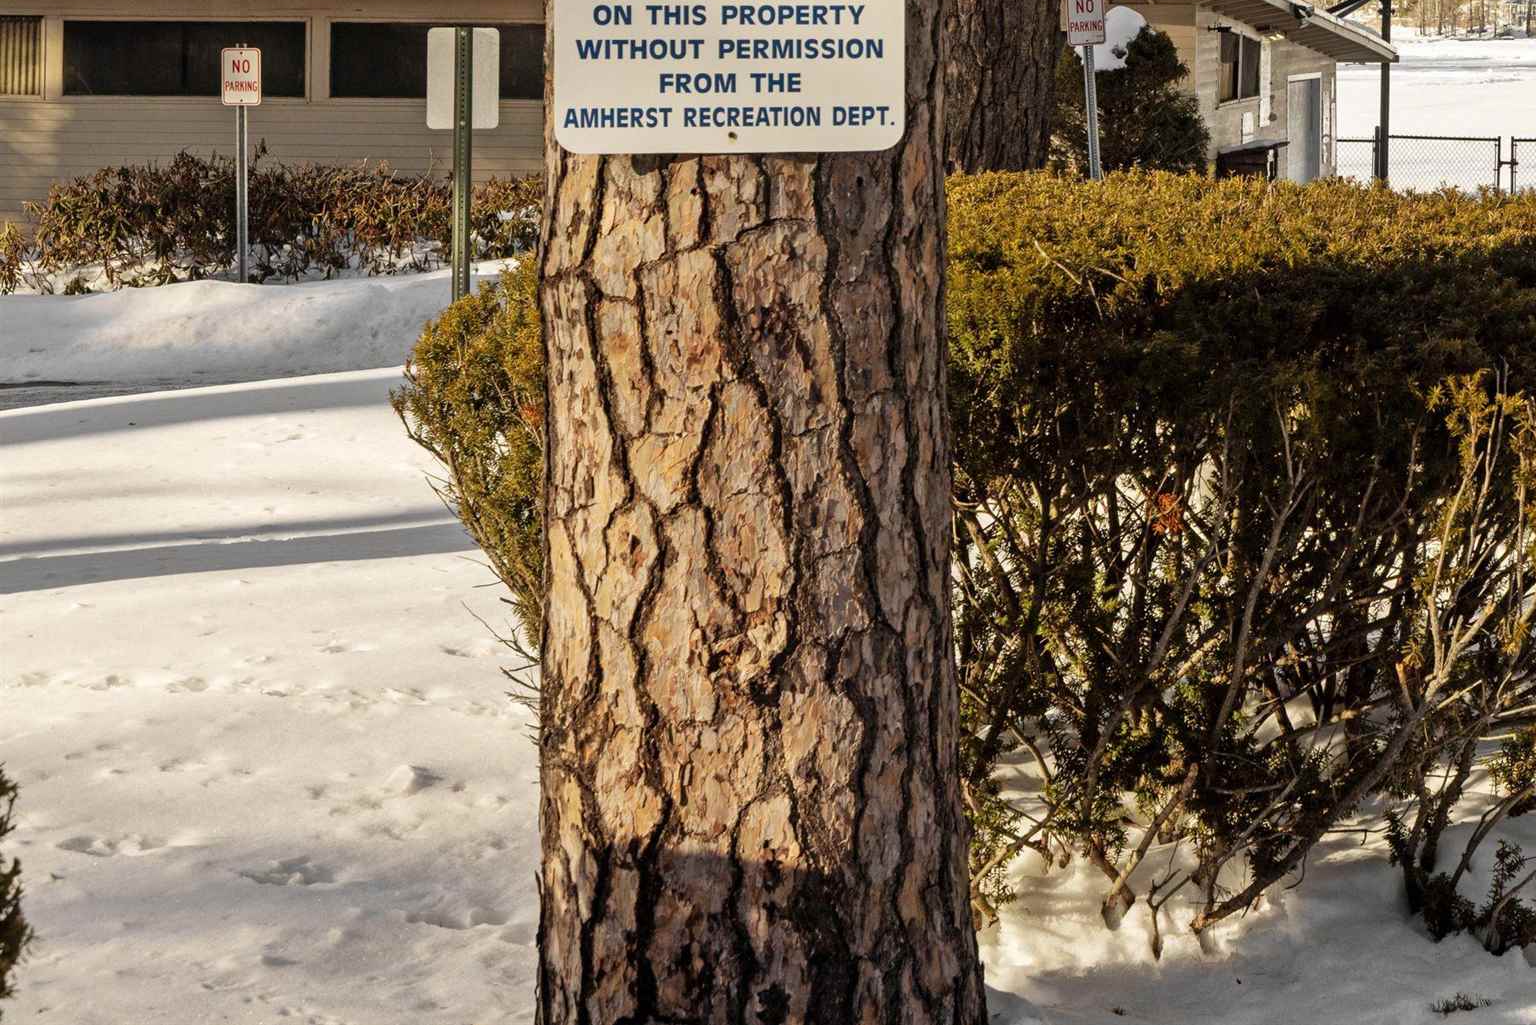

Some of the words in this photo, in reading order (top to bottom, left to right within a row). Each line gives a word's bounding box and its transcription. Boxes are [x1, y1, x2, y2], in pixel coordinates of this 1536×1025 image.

[592, 4, 632, 26] ON
[646, 5, 707, 26] THIS
[721, 5, 865, 26] PROPERTY
[1075, 0, 1095, 14] NO
[1070, 19, 1103, 33] PARKING
[576, 39, 704, 60] WITHOUT
[718, 38, 884, 59] PERMISSION
[232, 59, 250, 74] NO
[224, 80, 257, 92] PARKING
[659, 73, 737, 94] FROM
[750, 73, 801, 93] THE
[563, 107, 672, 128] AMHERST
[684, 106, 821, 128] RECREATION
[832, 106, 896, 127] DEPT.
